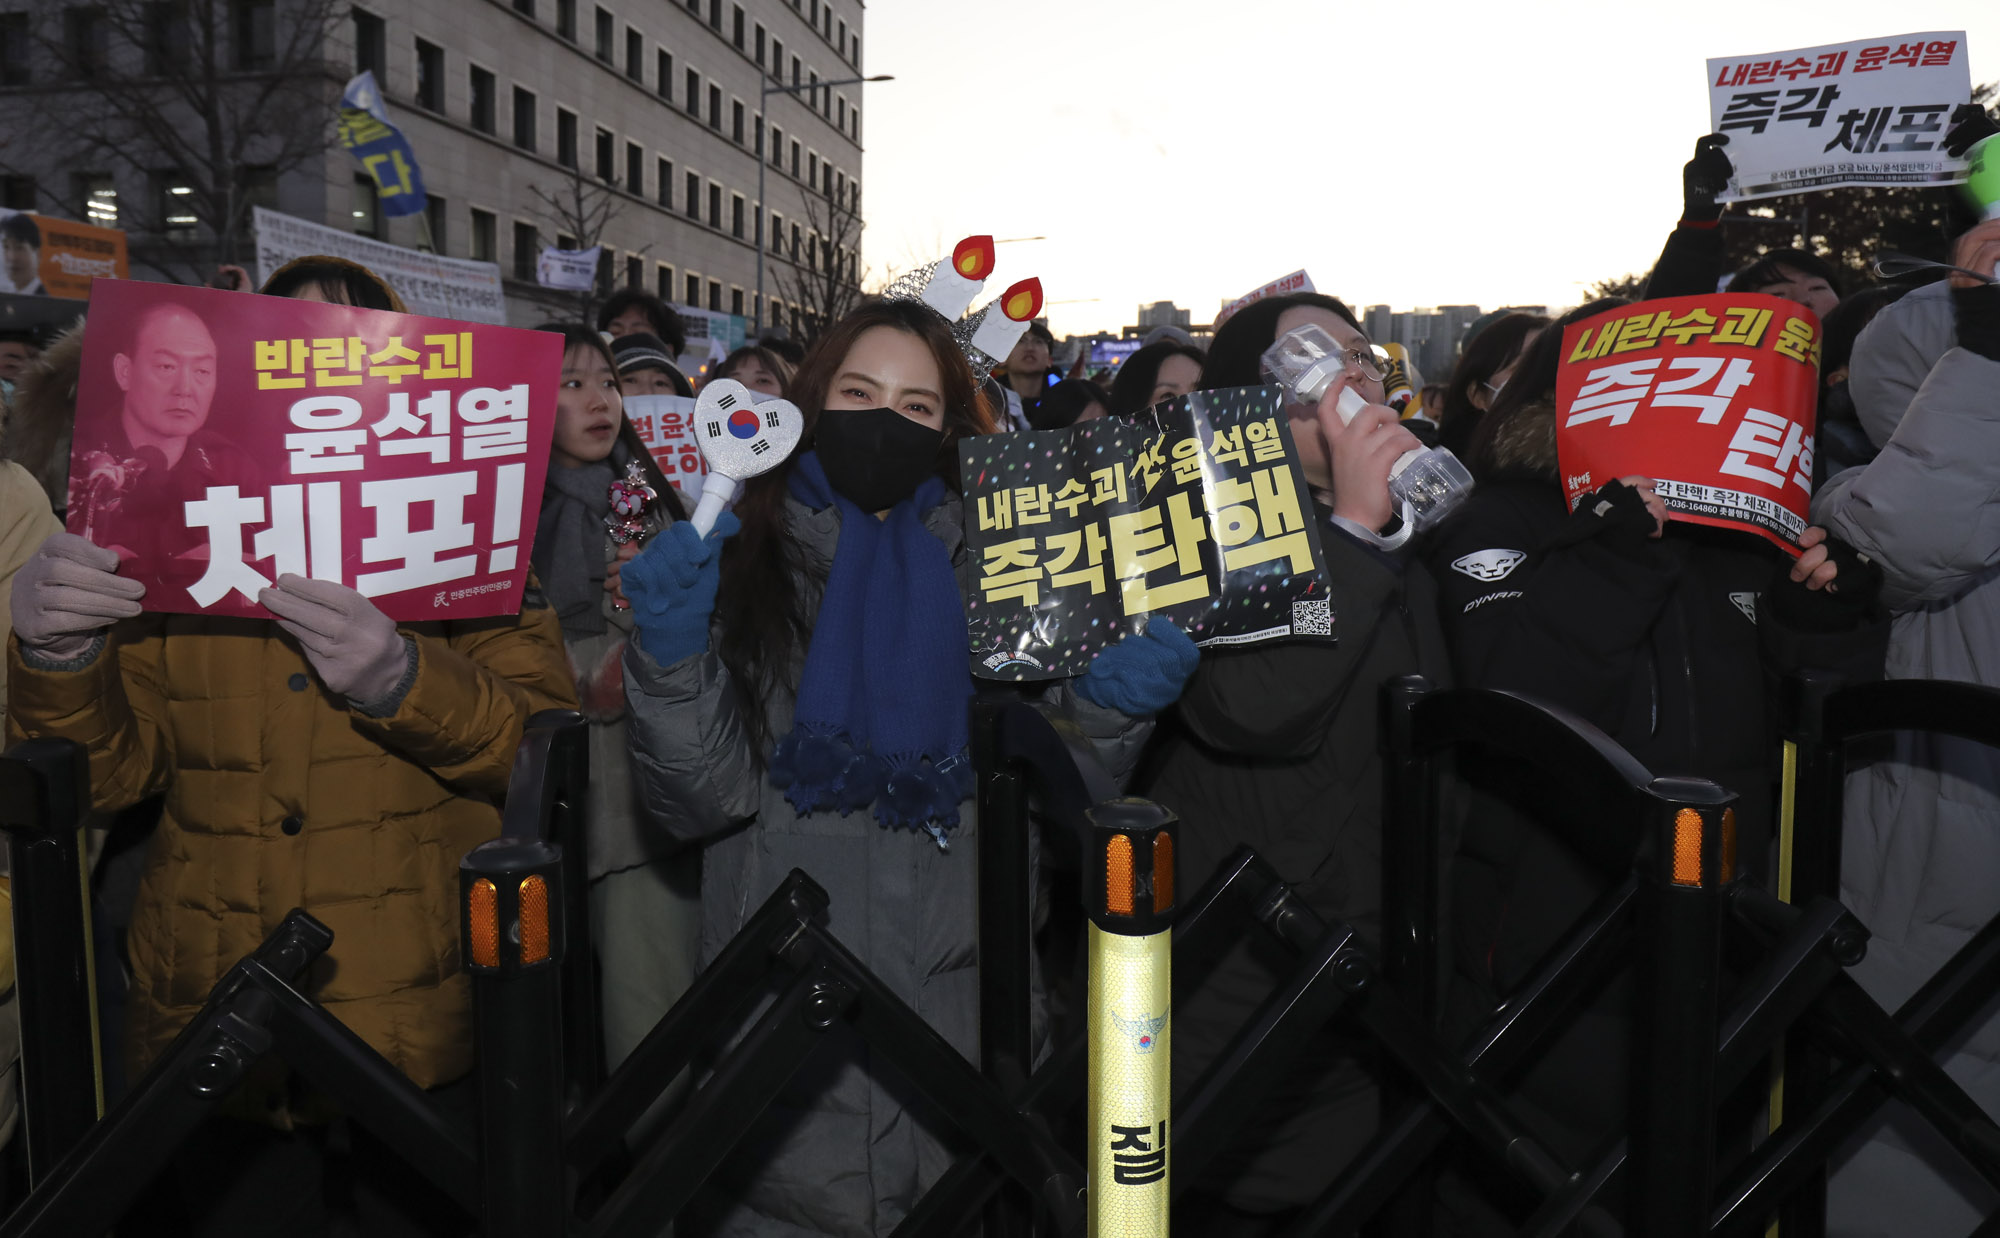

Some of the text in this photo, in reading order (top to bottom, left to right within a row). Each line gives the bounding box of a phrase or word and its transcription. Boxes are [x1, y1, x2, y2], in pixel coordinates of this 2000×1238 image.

[1715, 40, 1957, 87] 내란수괴 윤석열
[1718, 84, 1960, 154] 즉각 체포
[1771, 169, 1796, 181] 윤석열
[1799, 164, 1835, 177] 탄핵기금
[1838, 163, 1854, 172] 모금
[255, 332, 473, 390] 반란수괴
[1567, 307, 1775, 364] 내란수괴
[1565, 357, 1755, 427] 즉각
[285, 384, 530, 475] 윤석열
[977, 417, 1287, 532] 내란수괴 윤석열
[185, 463, 526, 608] 체포!
[1650, 481, 1809, 535] 각 탄핵! 즉각 체포! 될 때까지
[1662, 498, 1718, 514] 0-036-164860
[1719, 506, 1750, 520] 촛불행동
[1756, 514, 1768, 526] ARS
[980, 463, 1316, 617] 즉각 탄핵
[433, 591, 450, 608] 民
[450, 579, 512, 601] 민중민주당(민중당)
[1110, 1119, 1166, 1186] 질
